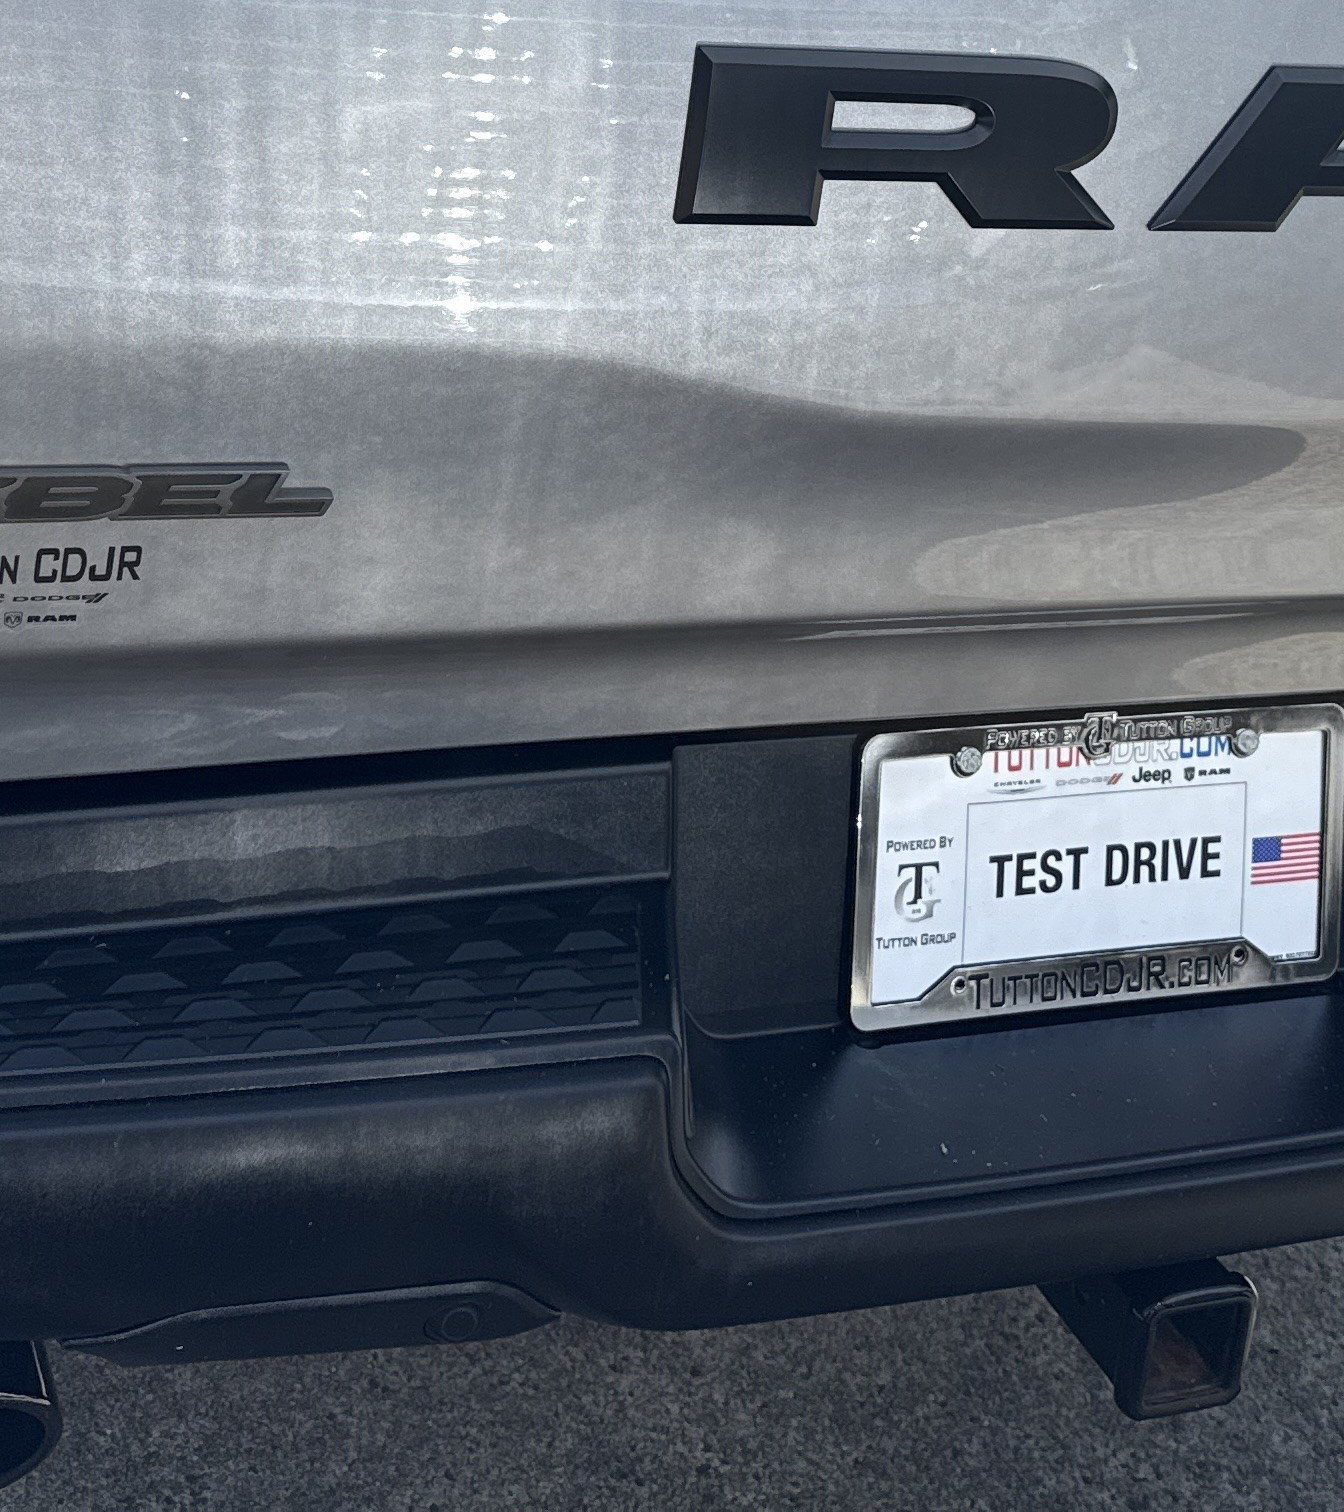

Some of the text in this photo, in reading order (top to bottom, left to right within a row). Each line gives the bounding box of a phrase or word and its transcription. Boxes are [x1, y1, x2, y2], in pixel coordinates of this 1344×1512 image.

[33, 545, 143, 584] CDJR
[12, 593, 94, 603] DODGE
[27, 614, 77, 623] RAM
[993, 735, 1233, 773] TUTTONDJR.COM
[1132, 766, 1171, 784] Jeep
[1198, 767, 1231, 777] RAM
[886, 839, 937, 853] POWERED
[989, 835, 1222, 898] TEST DRIVE
[875, 931, 956, 950] TUTTON GROUP
